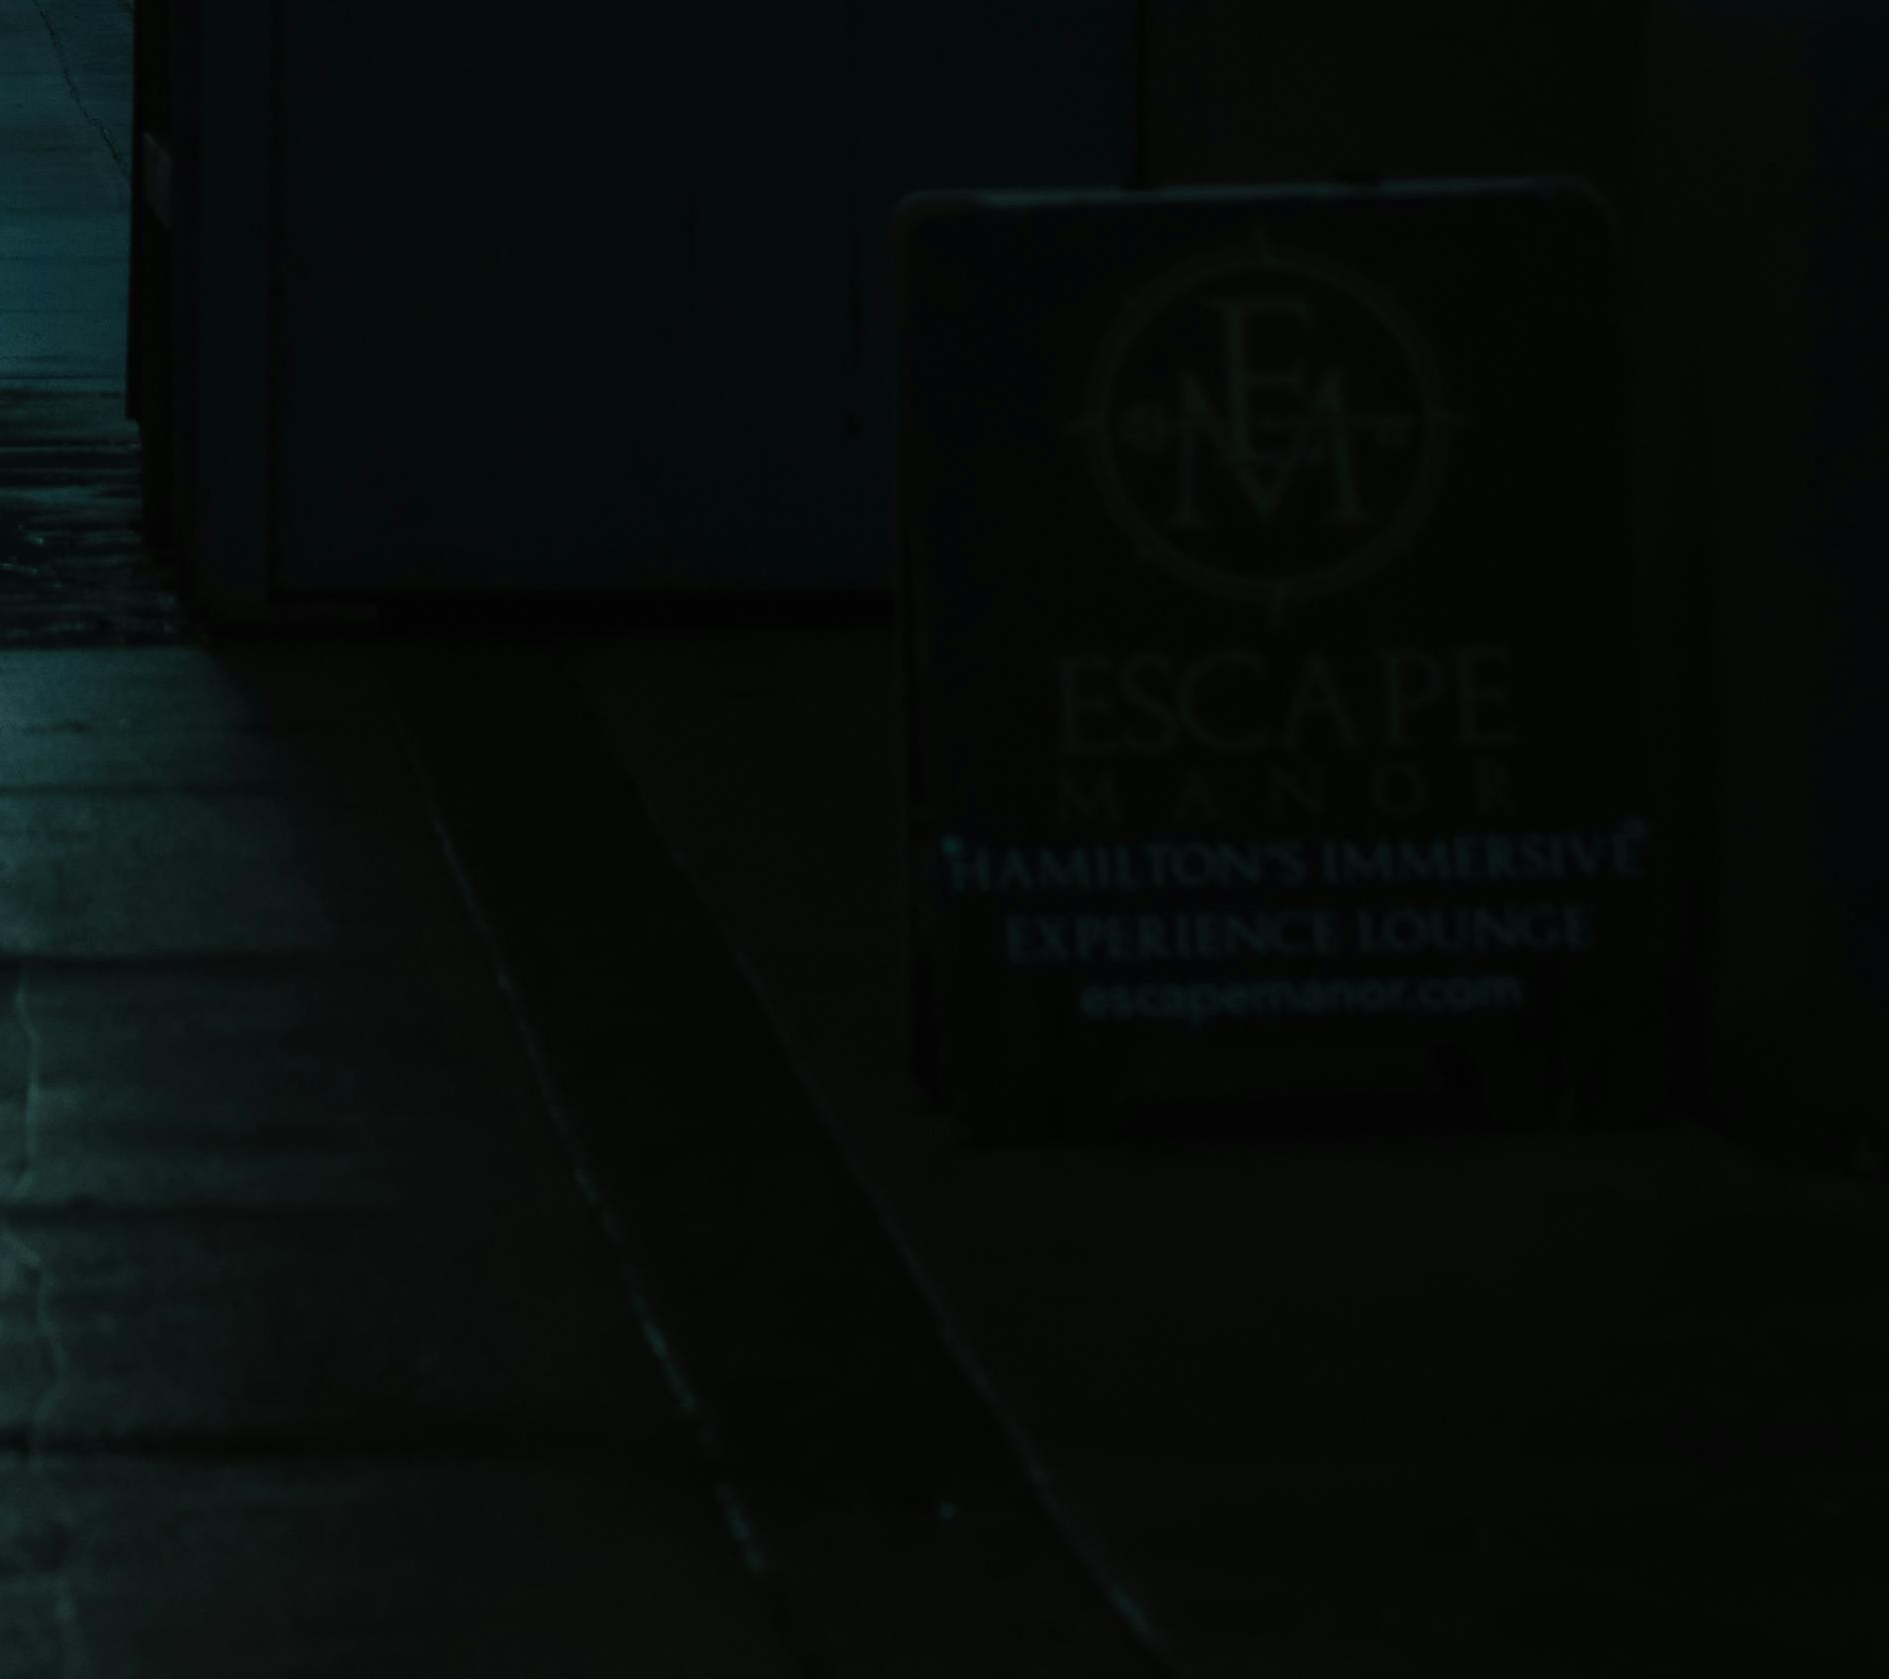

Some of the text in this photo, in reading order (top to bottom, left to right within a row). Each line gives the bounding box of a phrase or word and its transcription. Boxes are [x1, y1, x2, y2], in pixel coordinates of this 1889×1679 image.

[1054, 644, 1519, 758] ESCAPE
[1057, 761, 1517, 828] MANOR
[949, 831, 1646, 897] HAMILTON'S IMMERSIVE
[1004, 901, 1595, 965] EXPERIENCE LOUNGE
[1078, 974, 1523, 1025] escapemanor.com
